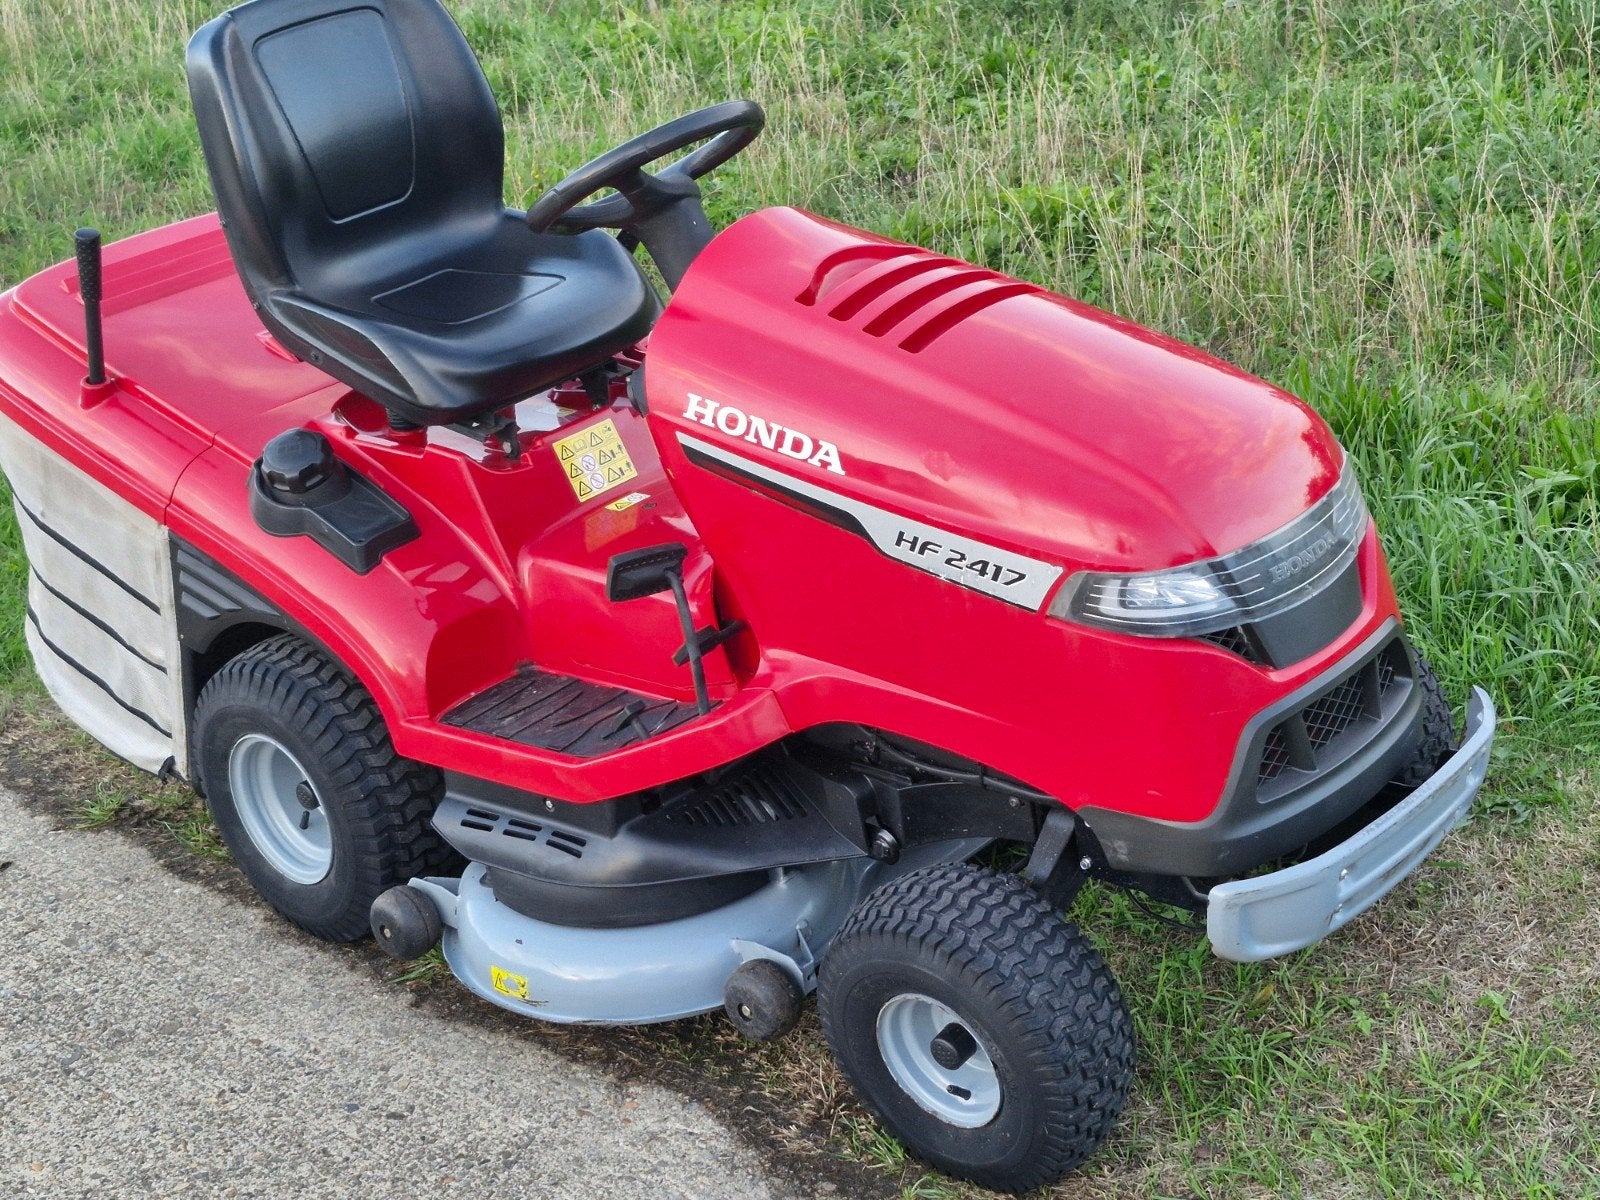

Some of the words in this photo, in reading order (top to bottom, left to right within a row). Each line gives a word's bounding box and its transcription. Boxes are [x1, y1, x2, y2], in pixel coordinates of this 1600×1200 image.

[683, 394, 846, 476] HONDA
[895, 530, 942, 557] HF
[944, 548, 1027, 587] 2417
